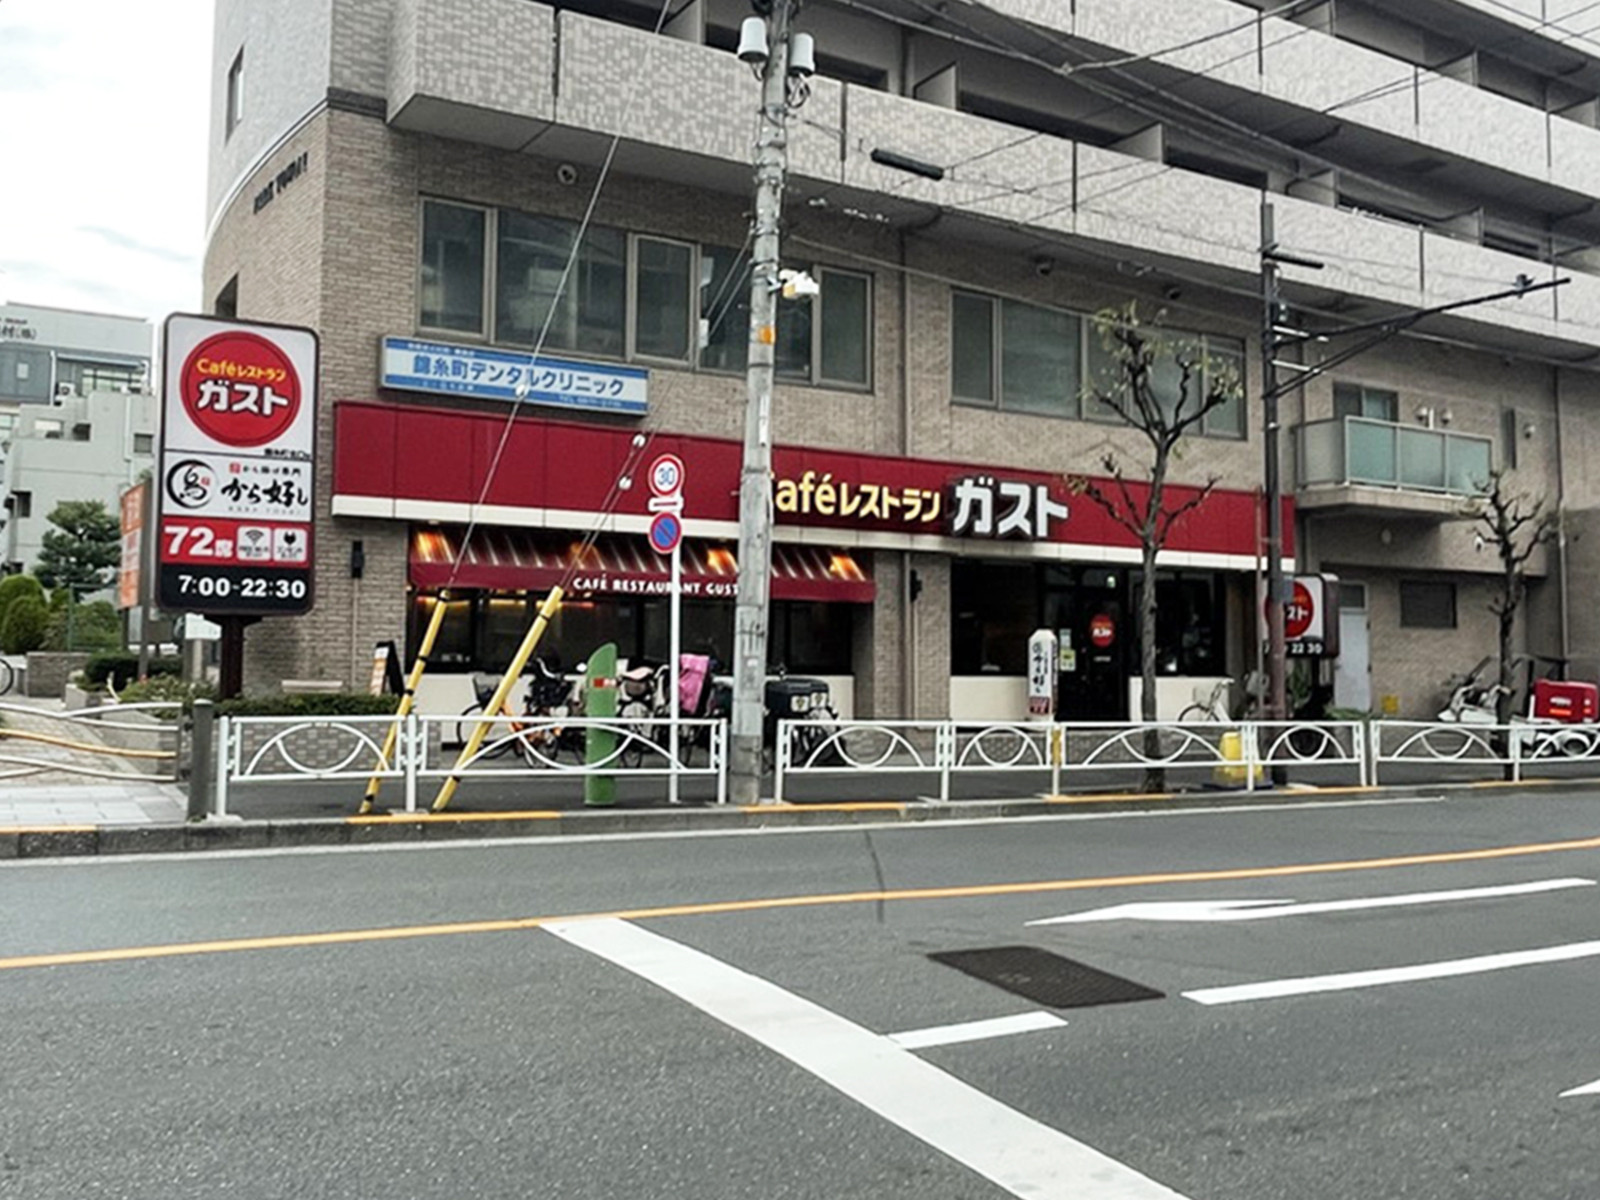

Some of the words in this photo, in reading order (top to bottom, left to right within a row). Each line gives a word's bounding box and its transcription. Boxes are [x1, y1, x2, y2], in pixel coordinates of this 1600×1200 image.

[197, 379, 289, 416] ガスト
[658, 467, 676, 486] 30
[220, 477, 309, 508] から好し
[770, 470, 941, 522] aféレストラン
[953, 476, 1069, 537] ガスト
[572, 573, 608, 591] CAFÉ
[1286, 605, 1309, 621] スト
[1291, 643, 1323, 655] 2230
